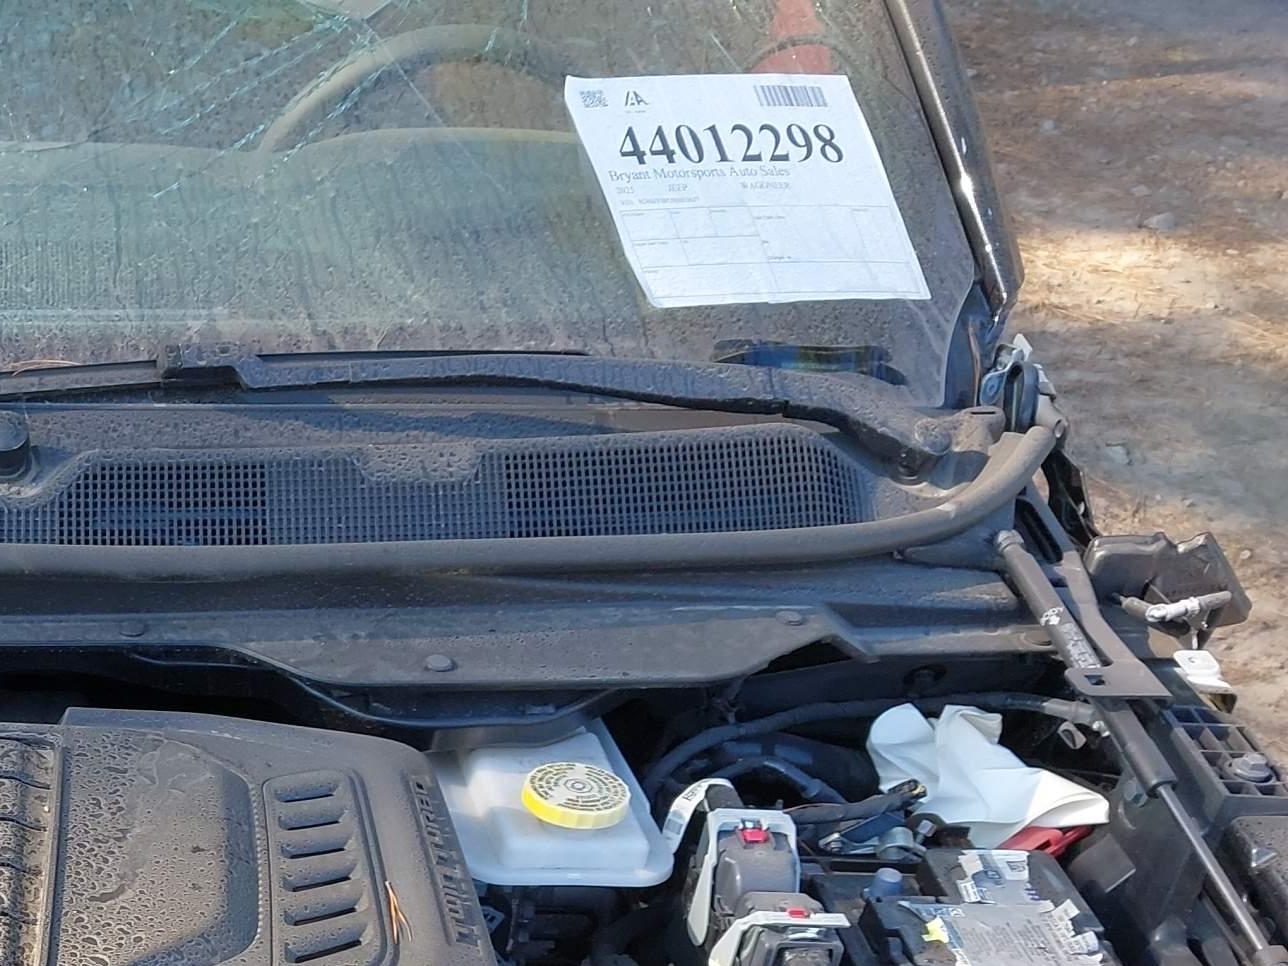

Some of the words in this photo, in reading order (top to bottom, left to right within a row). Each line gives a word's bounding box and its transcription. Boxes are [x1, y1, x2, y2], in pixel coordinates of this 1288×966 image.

[619, 123, 844, 165] 44012298
[608, 169, 650, 184] Bryant
[653, 167, 726, 181] Motorsports
[729, 166, 758, 177] Auto
[759, 165, 791, 177] Sales
[413, 777, 453, 868] TURBO
